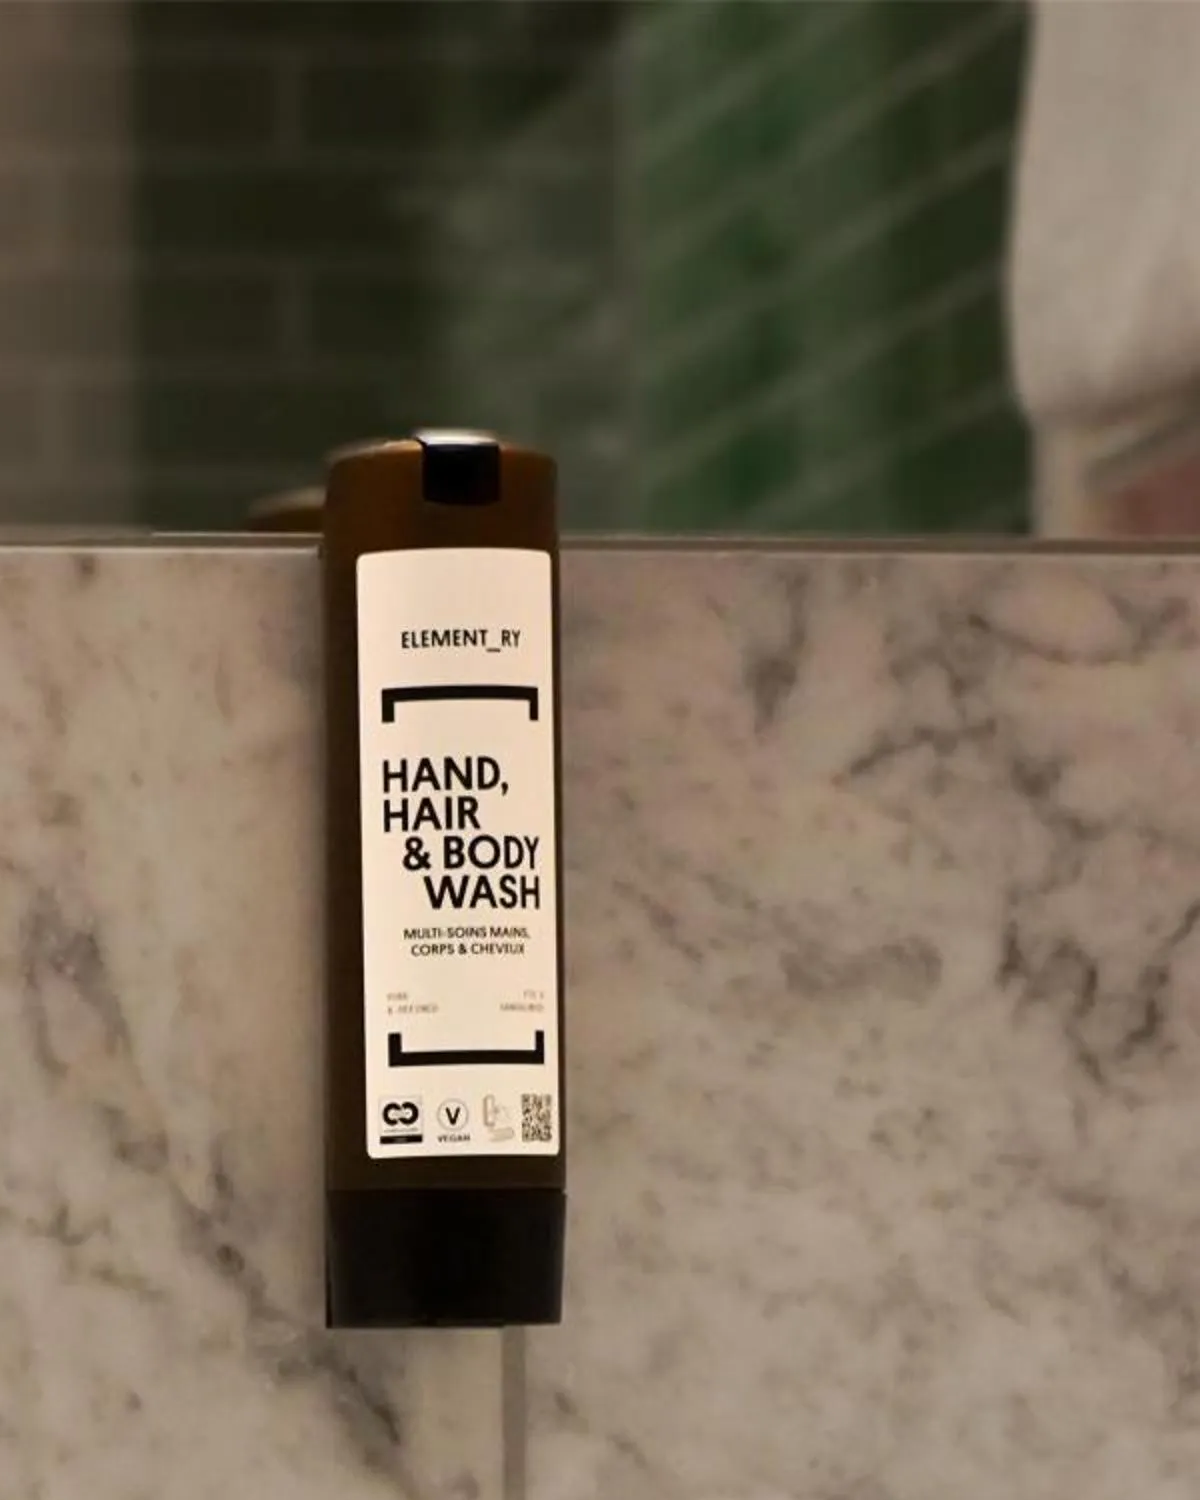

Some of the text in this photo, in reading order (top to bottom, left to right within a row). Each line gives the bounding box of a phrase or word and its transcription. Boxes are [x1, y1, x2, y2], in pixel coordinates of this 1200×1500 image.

[401, 629, 521, 653] ELEMENT_RY
[383, 756, 509, 796] HAND,
[383, 796, 481, 833] HAIR
[402, 834, 540, 871] & BODY
[423, 873, 540, 910] WASH
[410, 943, 455, 957] CORPS
[458, 943, 467, 955] &
[445, 1106, 461, 1126] V
